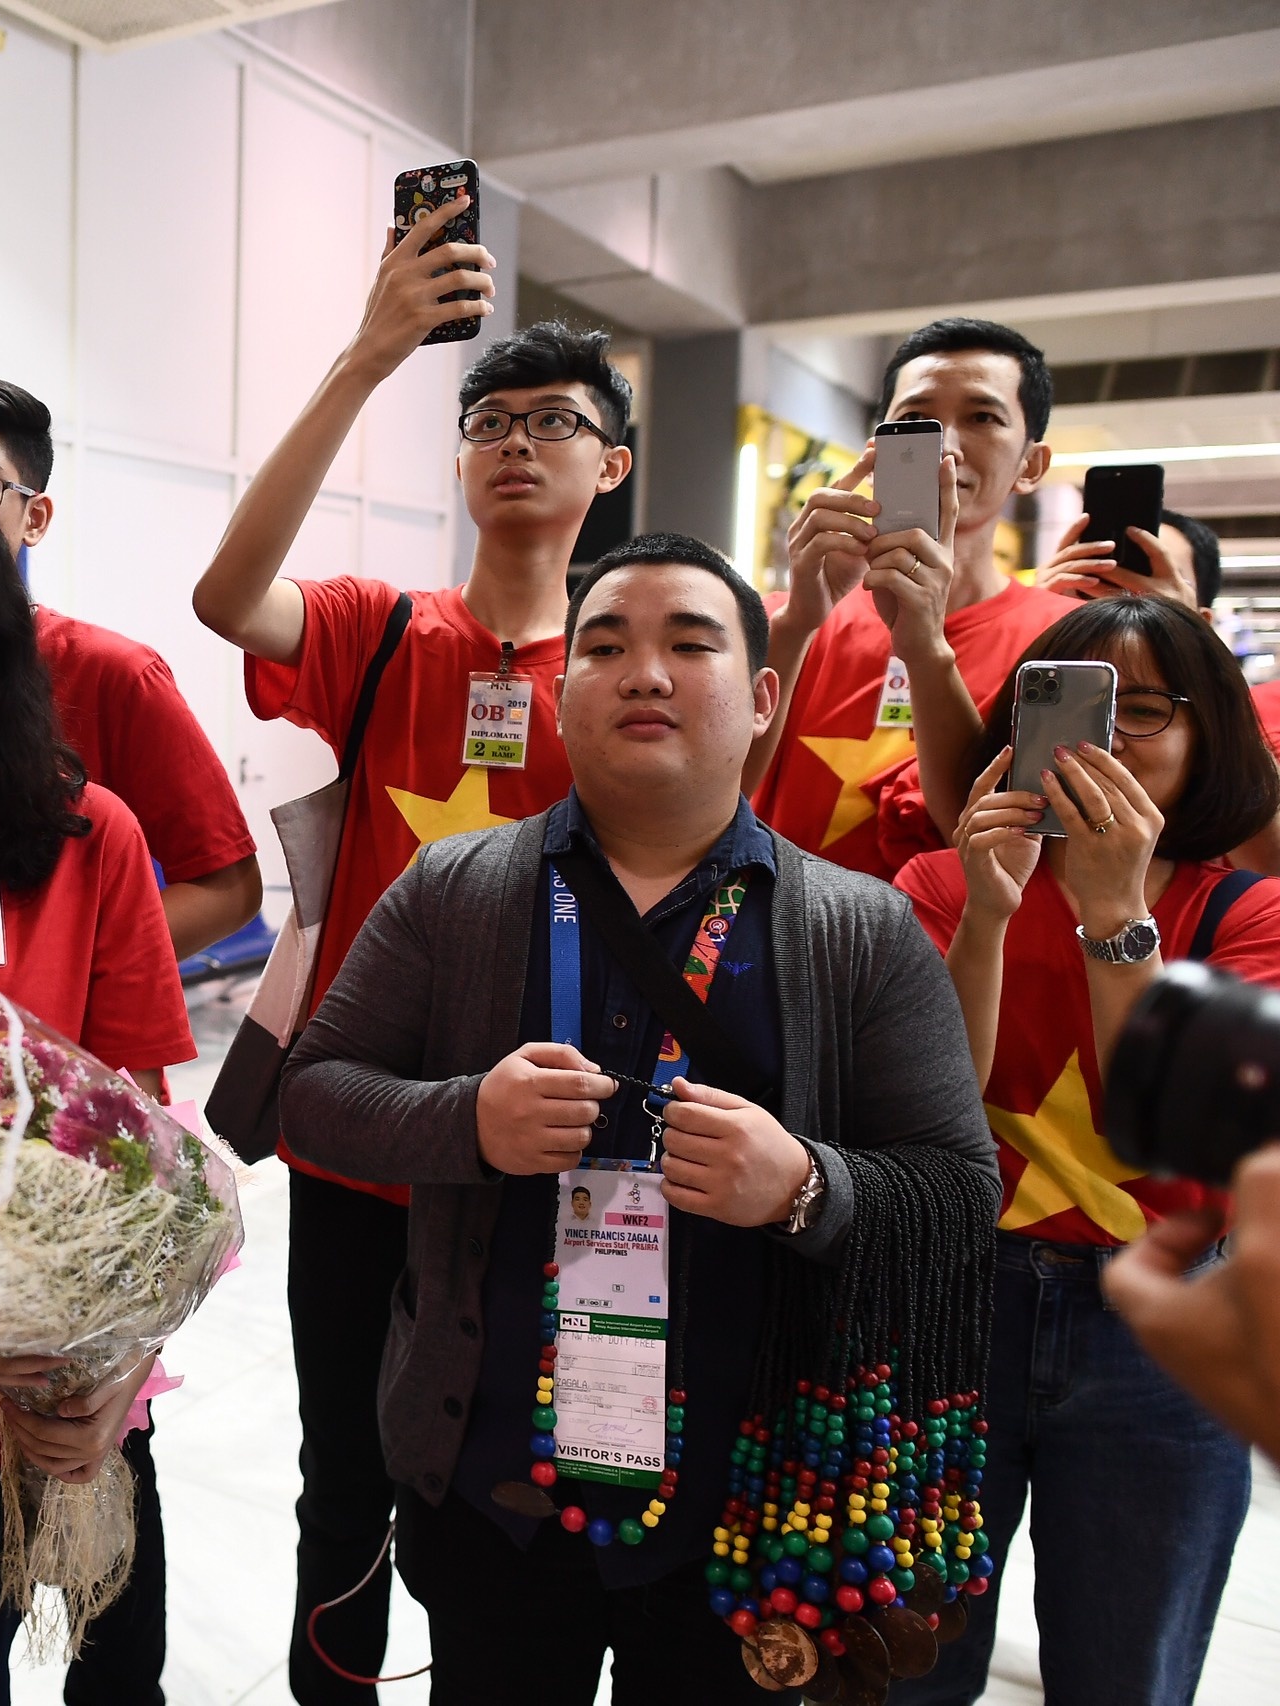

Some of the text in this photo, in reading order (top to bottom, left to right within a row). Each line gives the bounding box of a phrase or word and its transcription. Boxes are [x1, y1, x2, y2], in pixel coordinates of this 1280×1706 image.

[507, 700, 527, 708] 2019
[471, 704, 505, 721] OB
[888, 706, 900, 719] 2
[471, 730, 522, 739] DIPLOMATIC
[474, 742, 486, 757] 2
[491, 751, 516, 759] RAMP
[553, 893, 577, 924] ONE
[622, 1214, 649, 1227] WKF2
[564, 1228, 659, 1244] VINCE FRANCIS ZAGALA
[563, 1238, 585, 1248] Airport
[586, 1239, 612, 1248] Services
[613, 1241, 631, 1250] Staff,
[594, 1248, 628, 1256] PHILIPPINES
[562, 1317, 587, 1327] MNL
[558, 1444, 622, 1463] VISITOR'S
[626, 1453, 661, 1467] PASS
